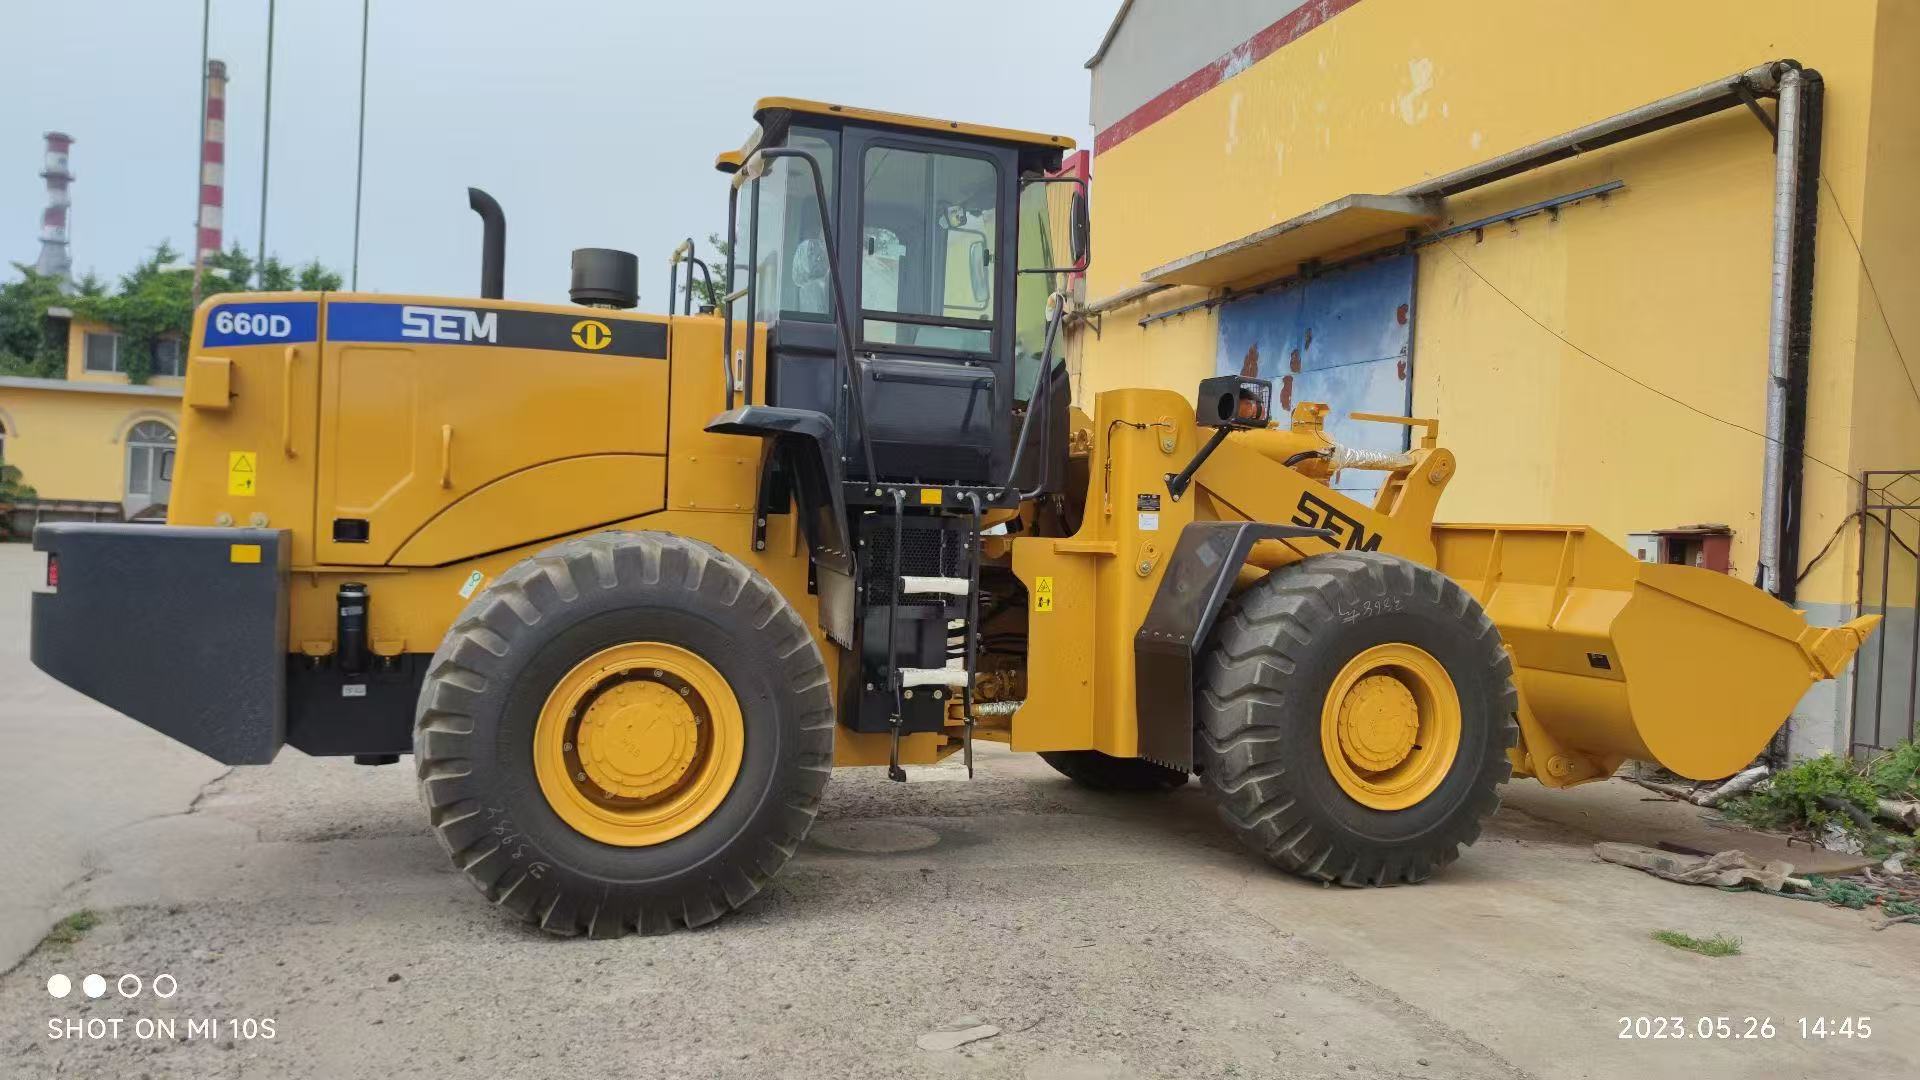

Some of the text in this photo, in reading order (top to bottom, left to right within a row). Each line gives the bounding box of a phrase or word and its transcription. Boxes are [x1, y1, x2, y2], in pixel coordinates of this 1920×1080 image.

[216, 311, 291, 337] 660D
[402, 306, 498, 343] SEM
[1291, 491, 1382, 552] SEM
